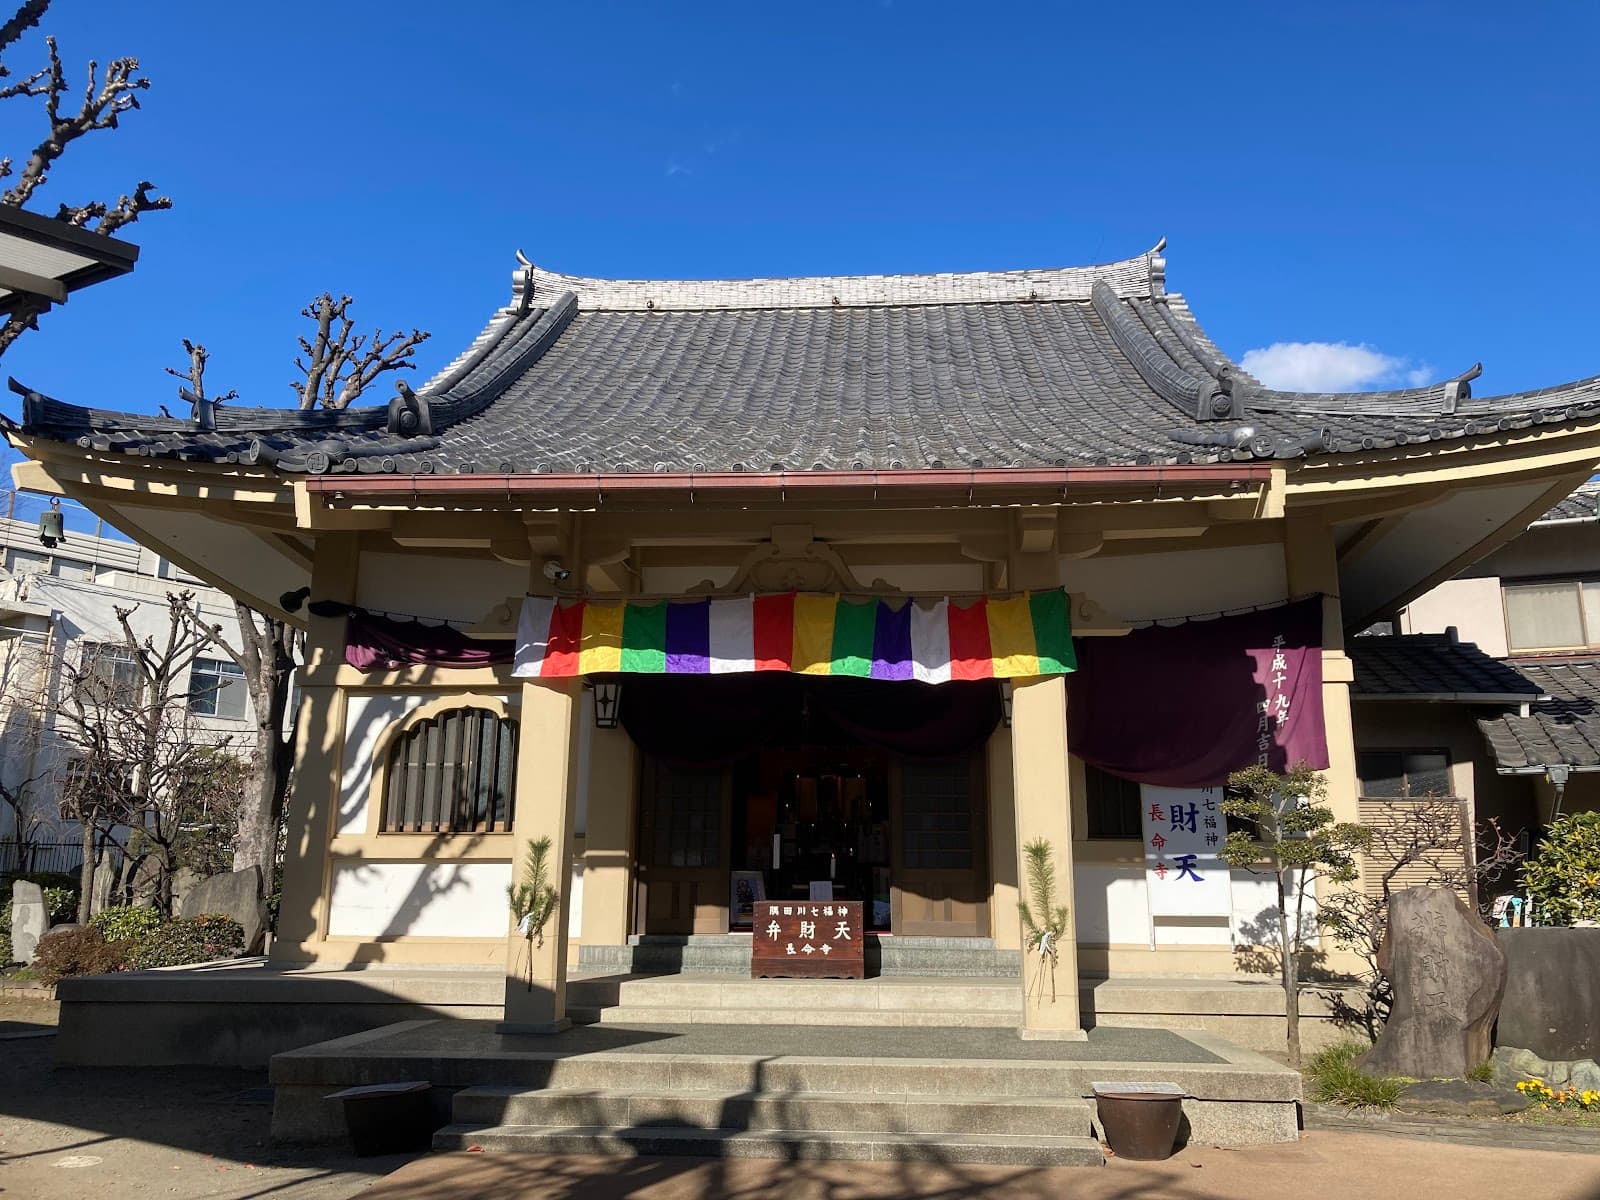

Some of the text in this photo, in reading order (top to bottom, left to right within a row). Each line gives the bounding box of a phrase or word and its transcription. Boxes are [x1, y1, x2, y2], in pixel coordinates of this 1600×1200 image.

[1271, 634, 1290, 728] 平成十九年
[1256, 699, 1271, 768] 四月吉日
[1148, 803, 1169, 880] 長命寺
[1170, 802, 1205, 882] 財天
[765, 919, 852, 941] 弁財天
[769, 905, 849, 917] 隅田川七福神
[785, 942, 833, 955] 長命寺
